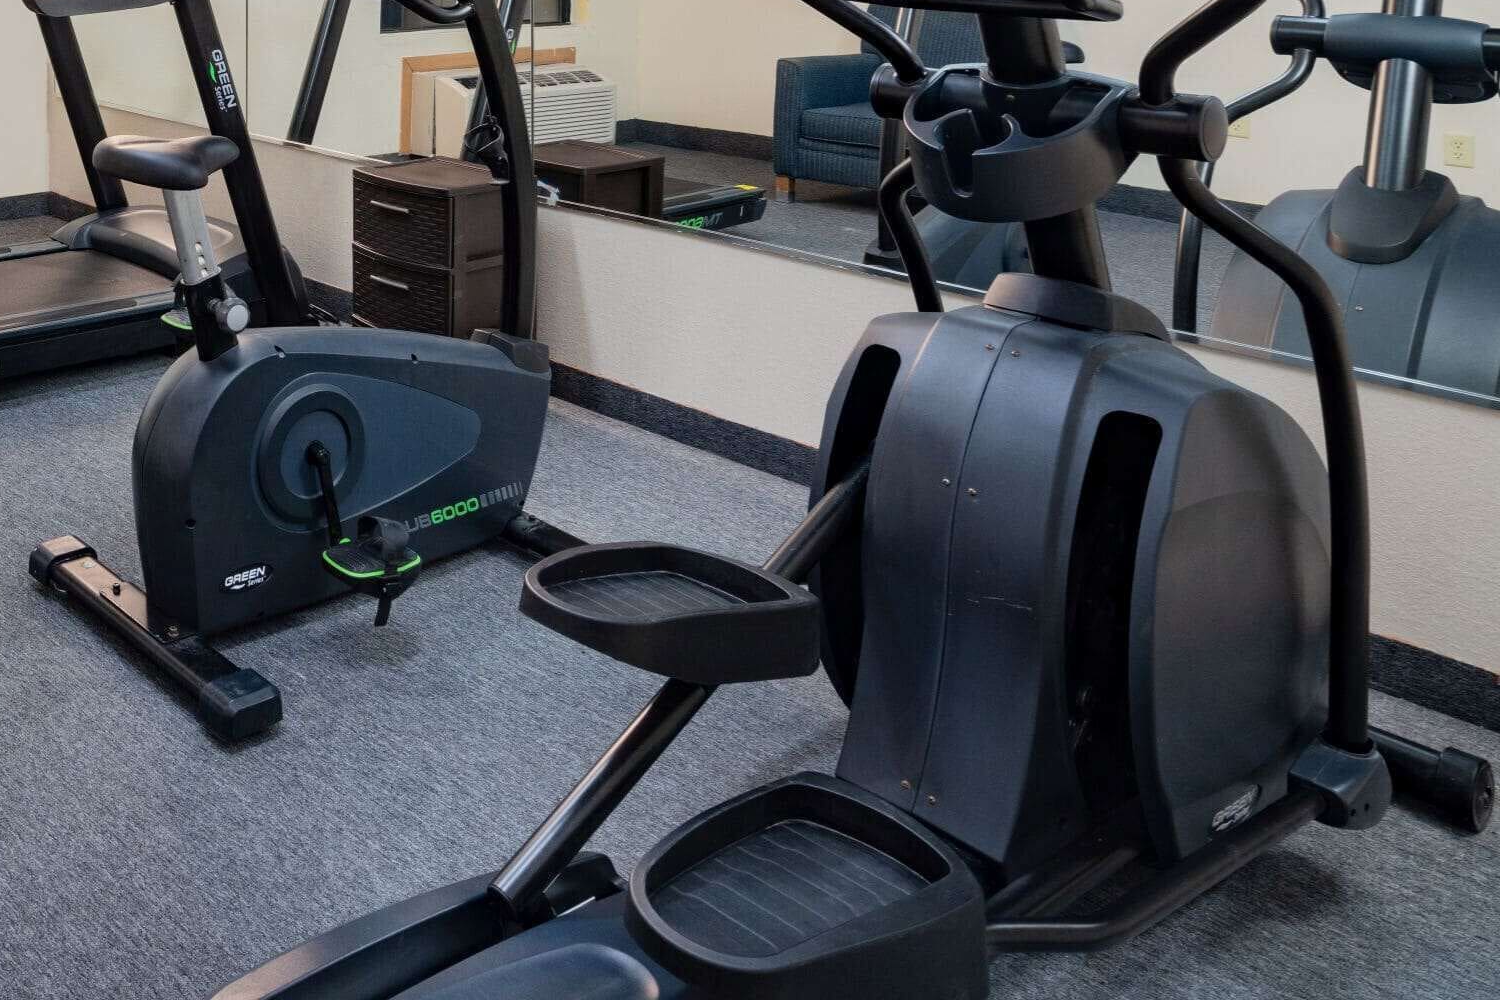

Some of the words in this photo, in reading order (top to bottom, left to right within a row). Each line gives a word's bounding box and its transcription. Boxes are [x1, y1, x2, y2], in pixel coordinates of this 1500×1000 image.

[211, 49, 237, 109] GREEN
[403, 497, 480, 533] UB6000
[224, 565, 266, 587] GREEN
